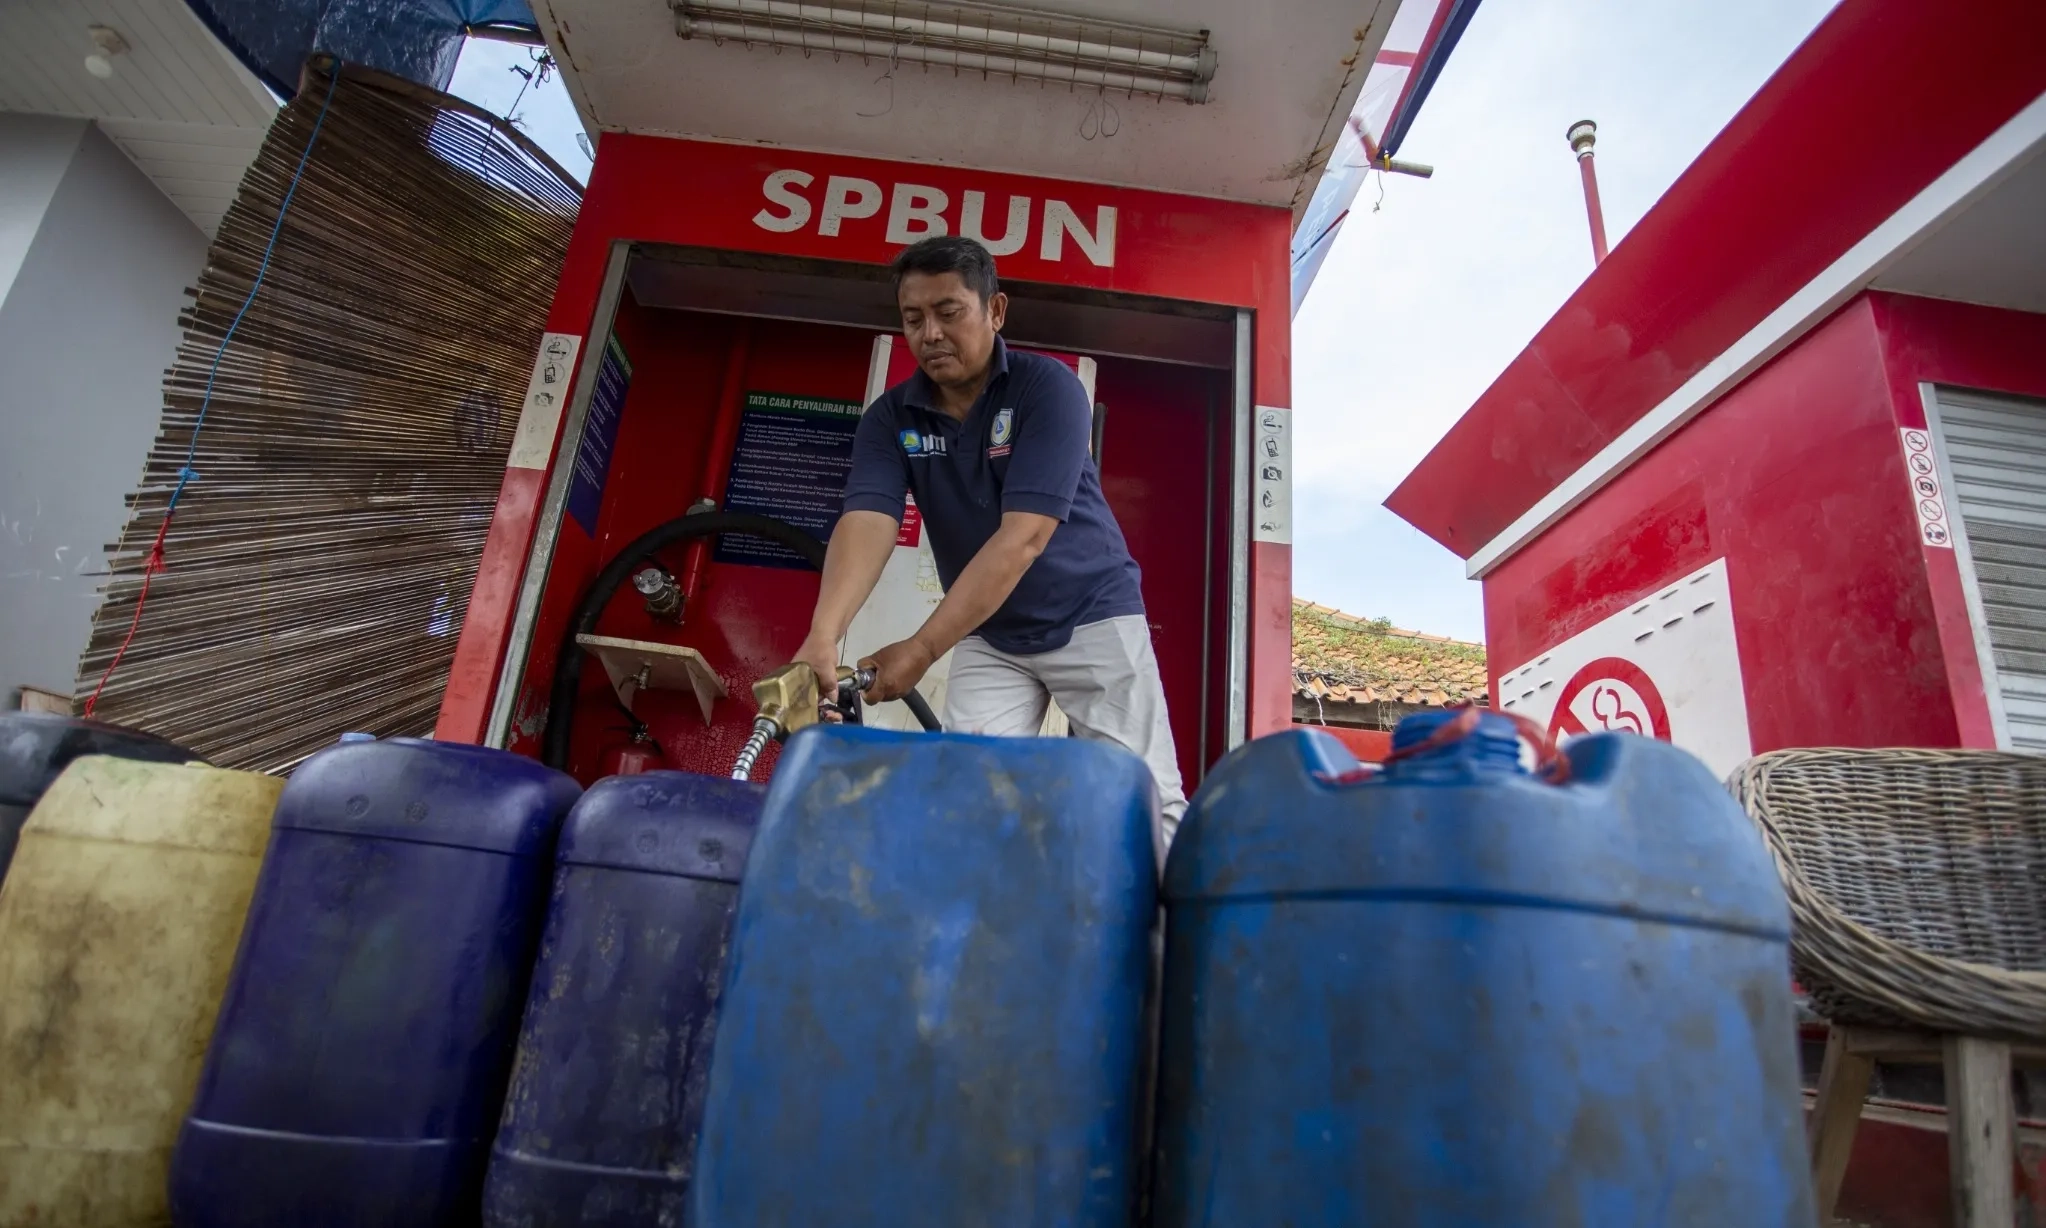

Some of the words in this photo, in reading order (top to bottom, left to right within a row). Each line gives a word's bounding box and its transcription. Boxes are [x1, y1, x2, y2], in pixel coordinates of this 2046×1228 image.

[752, 169, 1117, 268] SPBUN
[748, 394, 767, 406] TATA
[769, 396, 791, 408] CARA
[792, 399, 844, 414] PENYALURAN
